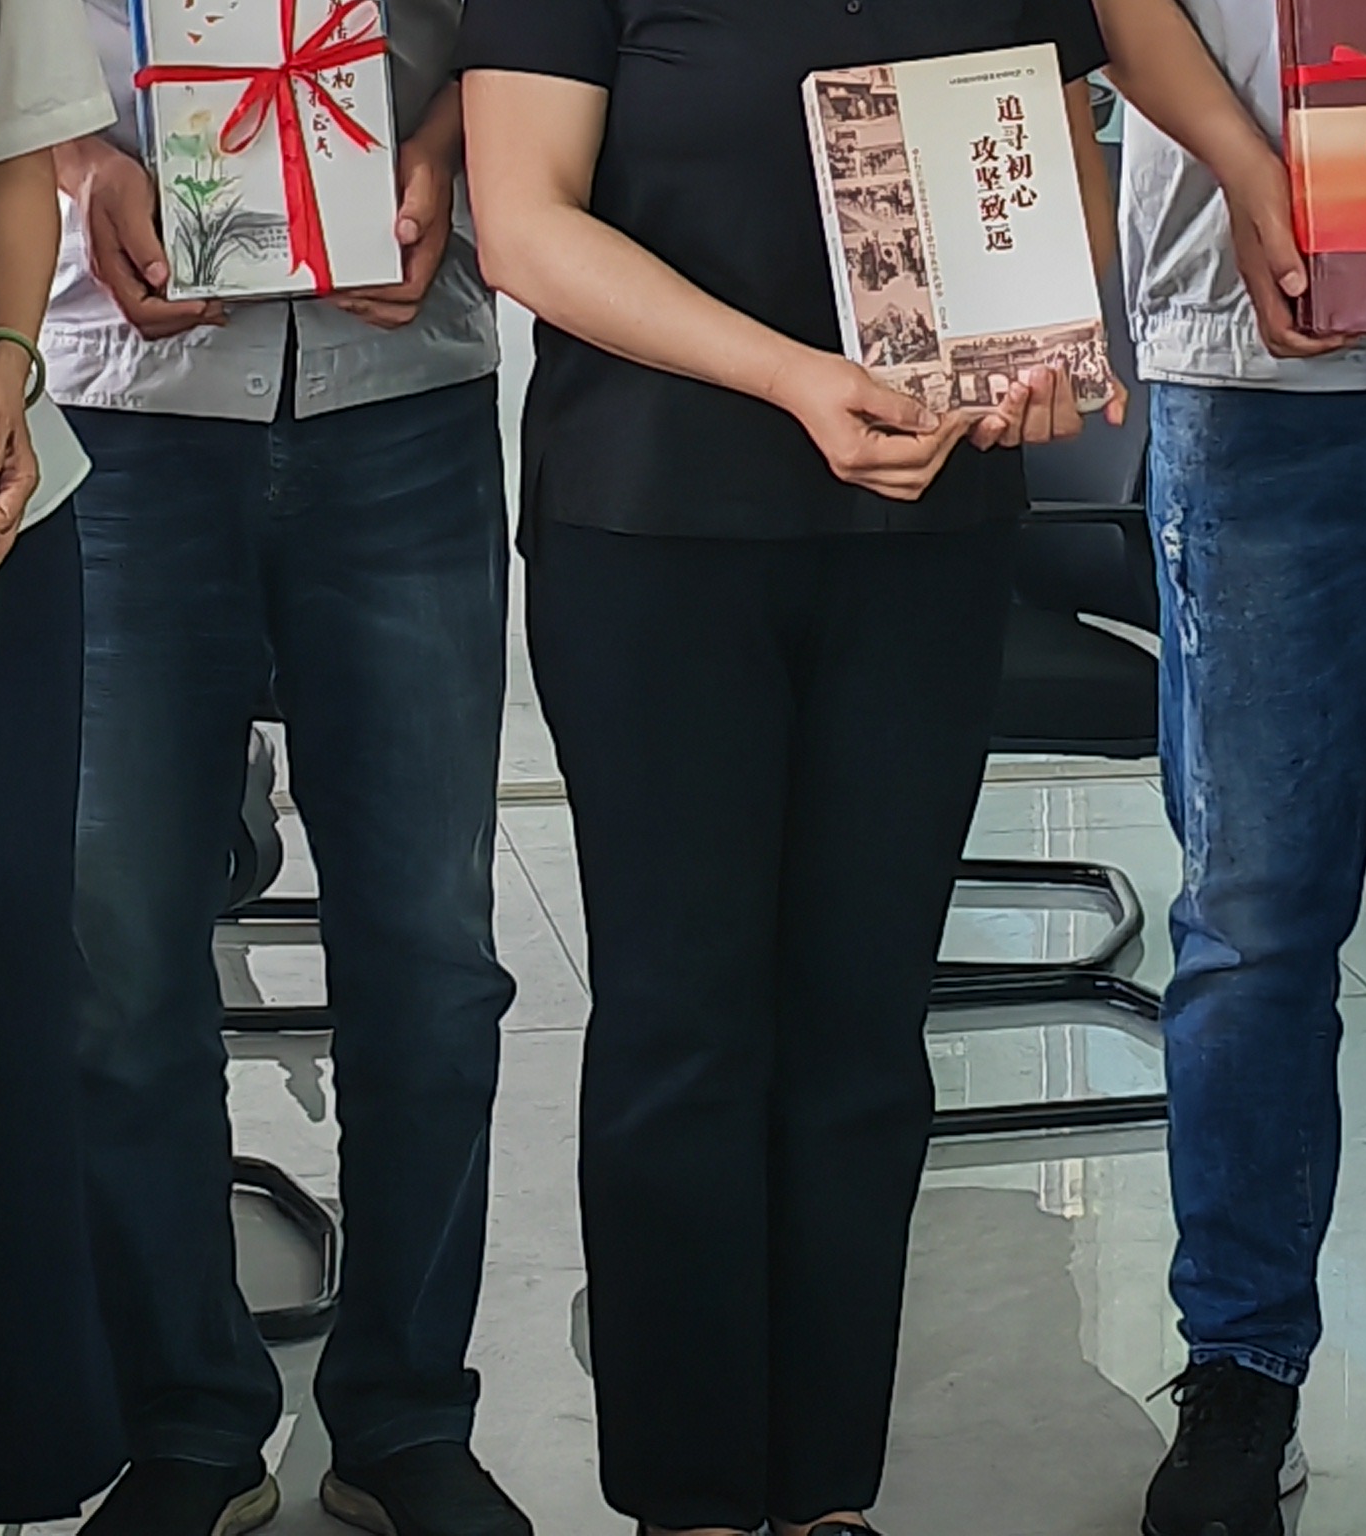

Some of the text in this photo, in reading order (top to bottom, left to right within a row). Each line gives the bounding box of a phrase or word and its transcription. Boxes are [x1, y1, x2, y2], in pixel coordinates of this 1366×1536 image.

[969, 135, 1014, 252] 攻坚致远
[996, 93, 1039, 210] 追寻初心
